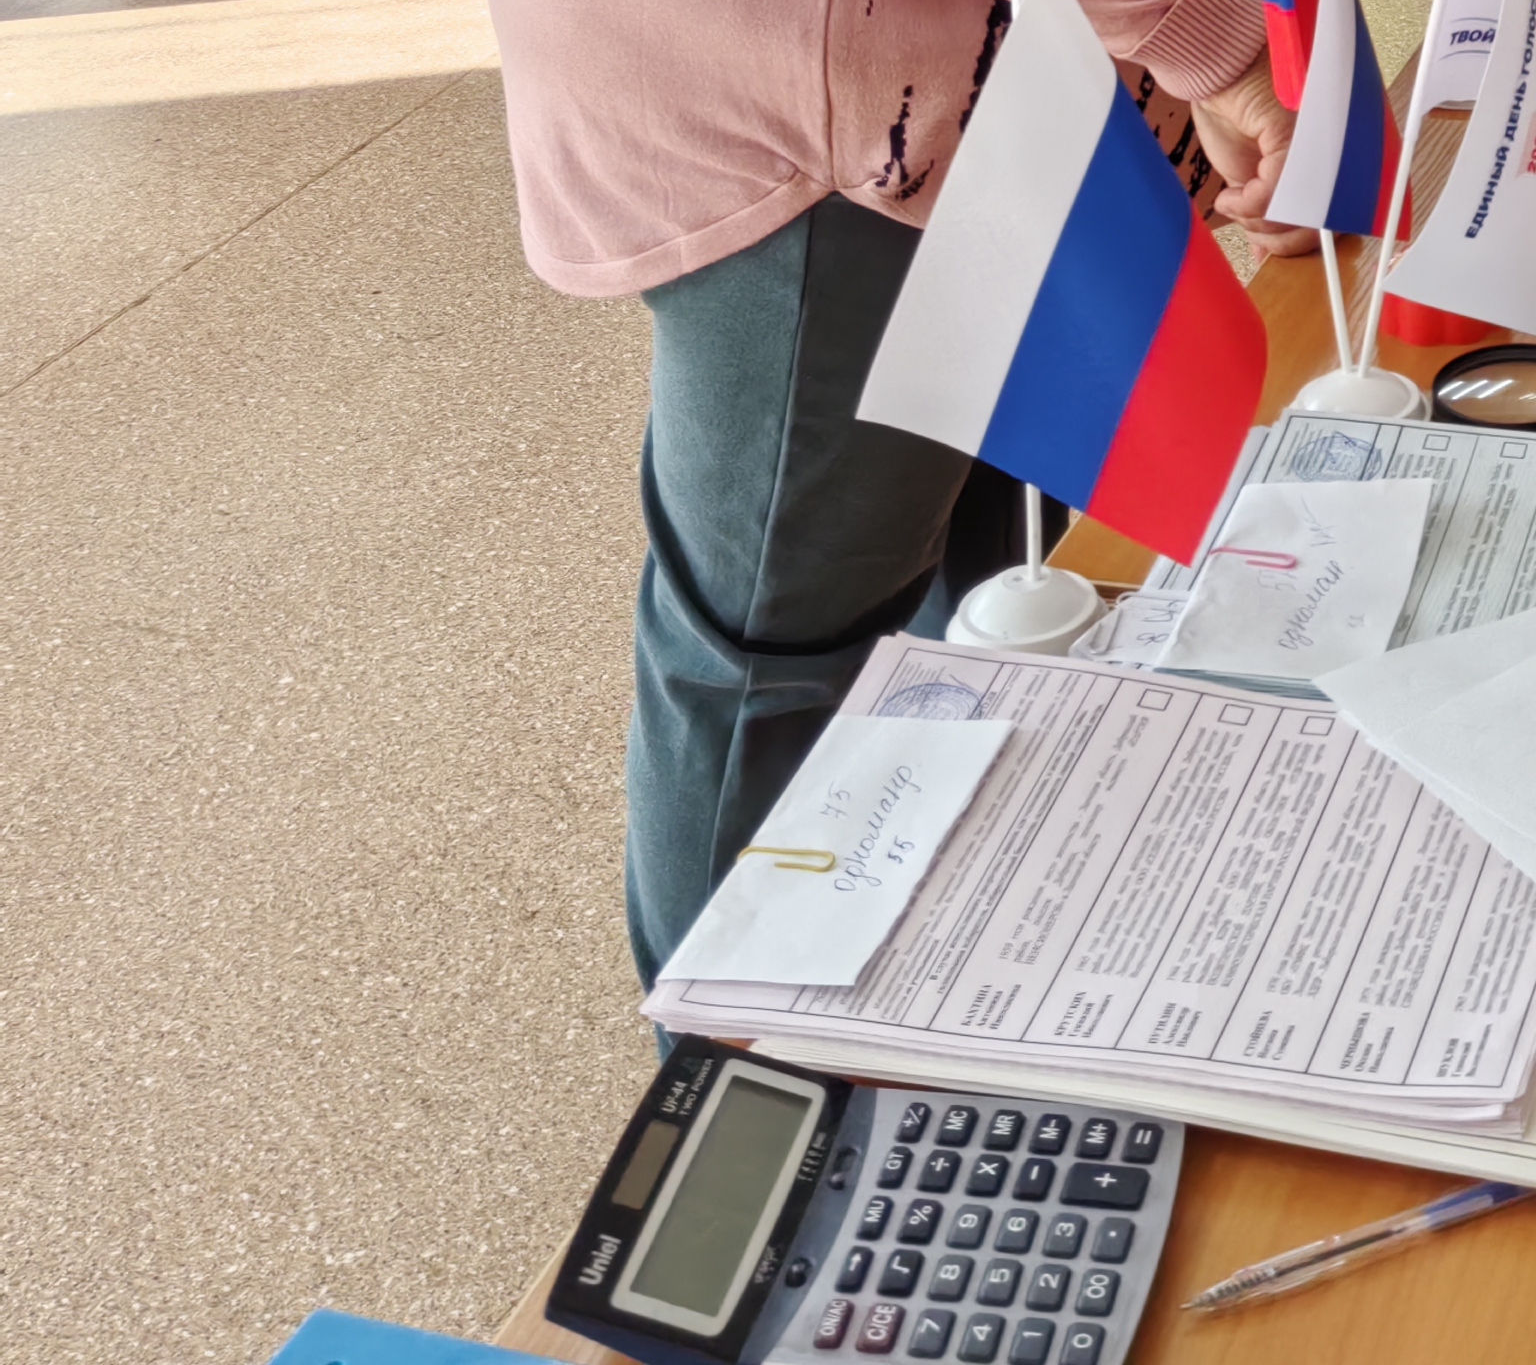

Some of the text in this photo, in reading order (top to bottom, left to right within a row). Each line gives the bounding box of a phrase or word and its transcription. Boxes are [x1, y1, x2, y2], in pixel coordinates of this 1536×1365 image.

[1449, 27, 1497, 46] ТВОЙ
[1464, 80, 1528, 239] ЕДИНЫЙ ДЕНЬ
[678, 1058, 715, 1117] TWO POWER
[946, 1110, 969, 1132] MC
[993, 1112, 1017, 1136] MR
[1085, 1121, 1110, 1145] M+
[886, 1150, 905, 1171] GT
[865, 1198, 884, 1223] MU
[958, 1211, 979, 1230] 9
[1006, 1216, 1029, 1232] 6
[1054, 1220, 1075, 1238] 3
[578, 1233, 622, 1286] Uniel
[940, 1261, 960, 1281] 8
[988, 1265, 1011, 1283] 5
[1039, 1272, 1060, 1290] 2
[1087, 1272, 1109, 1300] 00
[818, 1298, 848, 1339] ON/AC
[864, 1303, 897, 1342] C/CE
[917, 1318, 940, 1338] 7
[972, 1322, 991, 1342] 4
[1021, 1329, 1042, 1339] 1
[1072, 1332, 1093, 1350] 0
